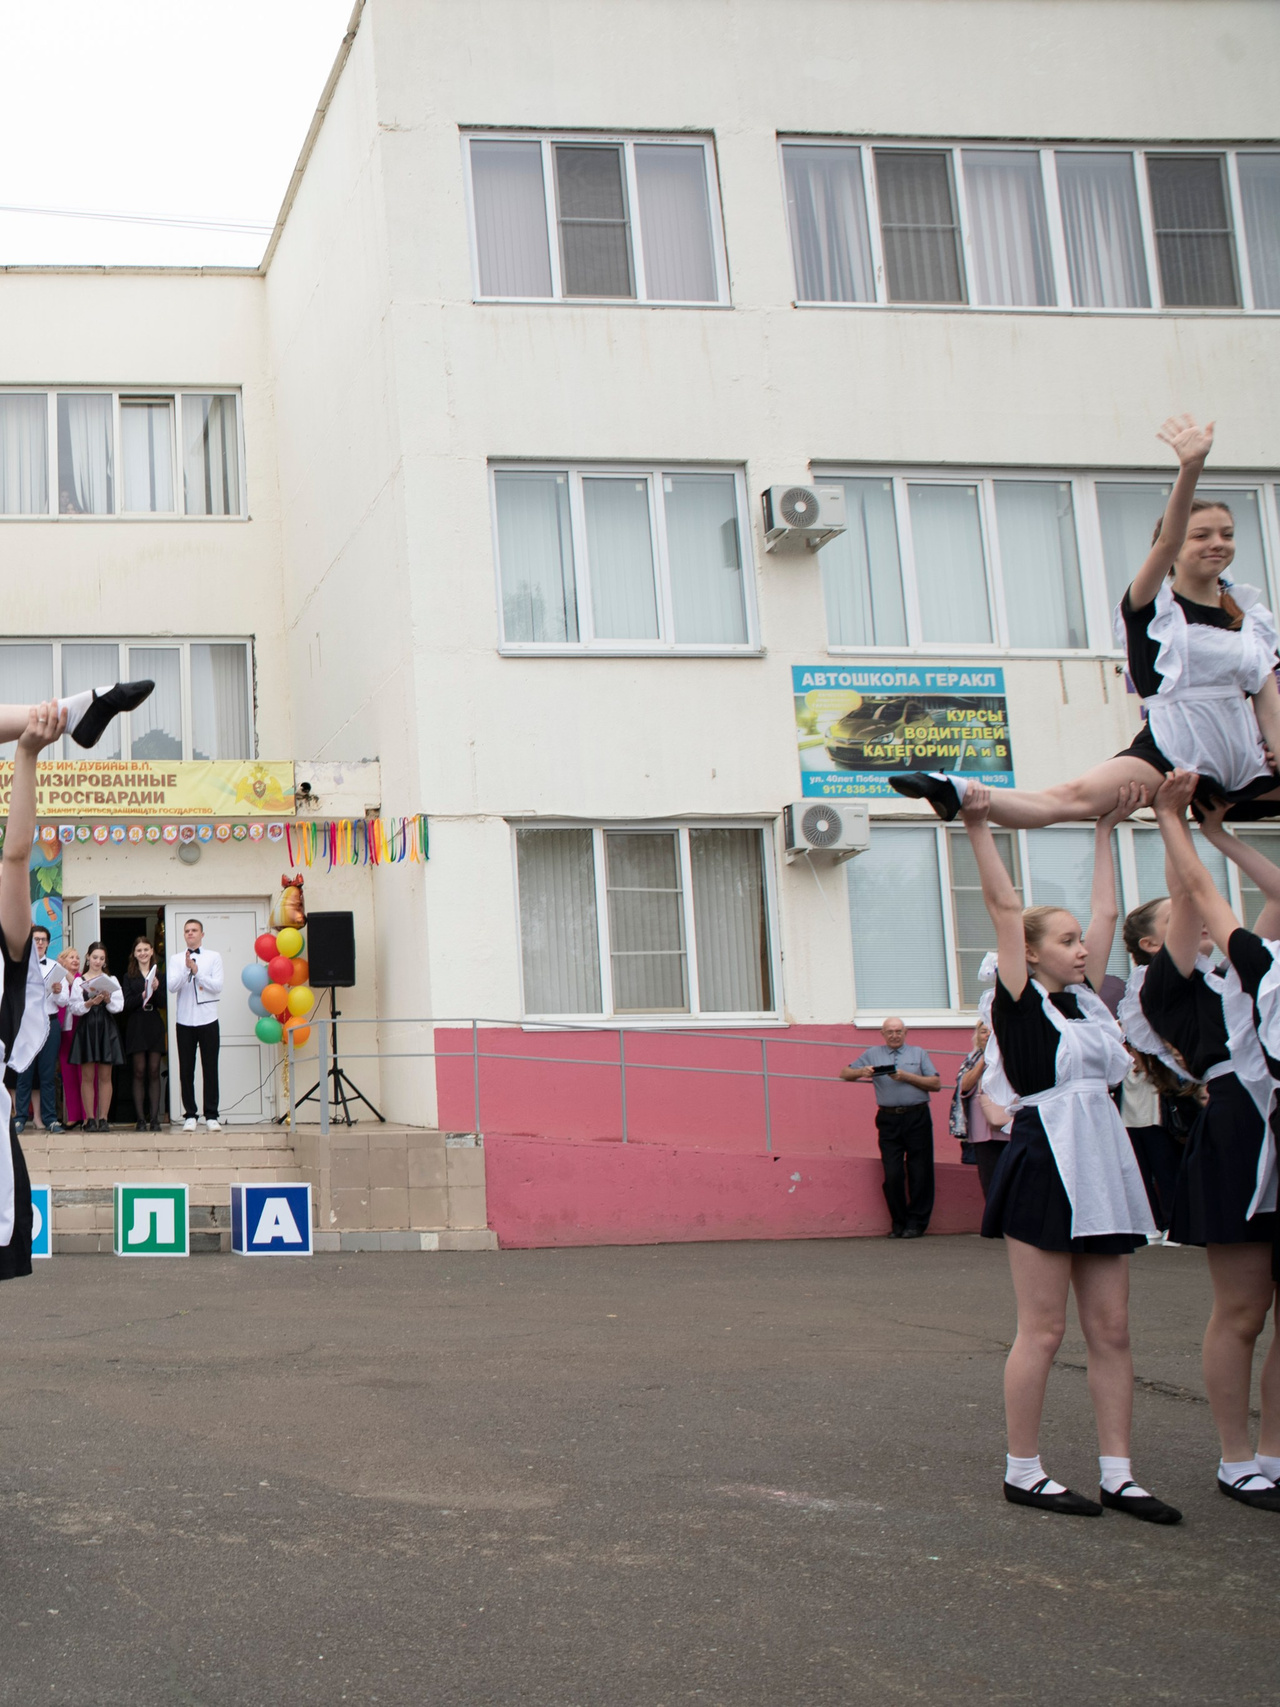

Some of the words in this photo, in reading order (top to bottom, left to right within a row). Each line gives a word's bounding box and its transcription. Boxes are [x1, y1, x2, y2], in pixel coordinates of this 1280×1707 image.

[802, 672, 921, 687] АВТОШКОЛА
[925, 673, 996, 687] ГЕРАКЛ
[946, 709, 1003, 722] КУРСЫ
[904, 725, 1005, 743] ВОДИТЕЛЕЙ
[863, 744, 960, 758] КАТЕГОРИИ
[965, 745, 977, 757] А
[980, 748, 991, 757] и
[996, 745, 1007, 757] В
[56, 762, 76, 771] ИМ.
[78, 761, 128, 773] ДУБИНЫ
[131, 762, 152, 771] В.П.
[809, 776, 824, 785] ул.
[49, 790, 165, 807] РОСГВАРДИИ
[47, 807, 76, 815] ЗНАЧИТ
[77, 807, 112, 815] УЧИТЬСЯ
[113, 807, 157, 815] ЗАЩИЩАТЬ
[158, 807, 213, 815] ГОСУДАРСТВО
